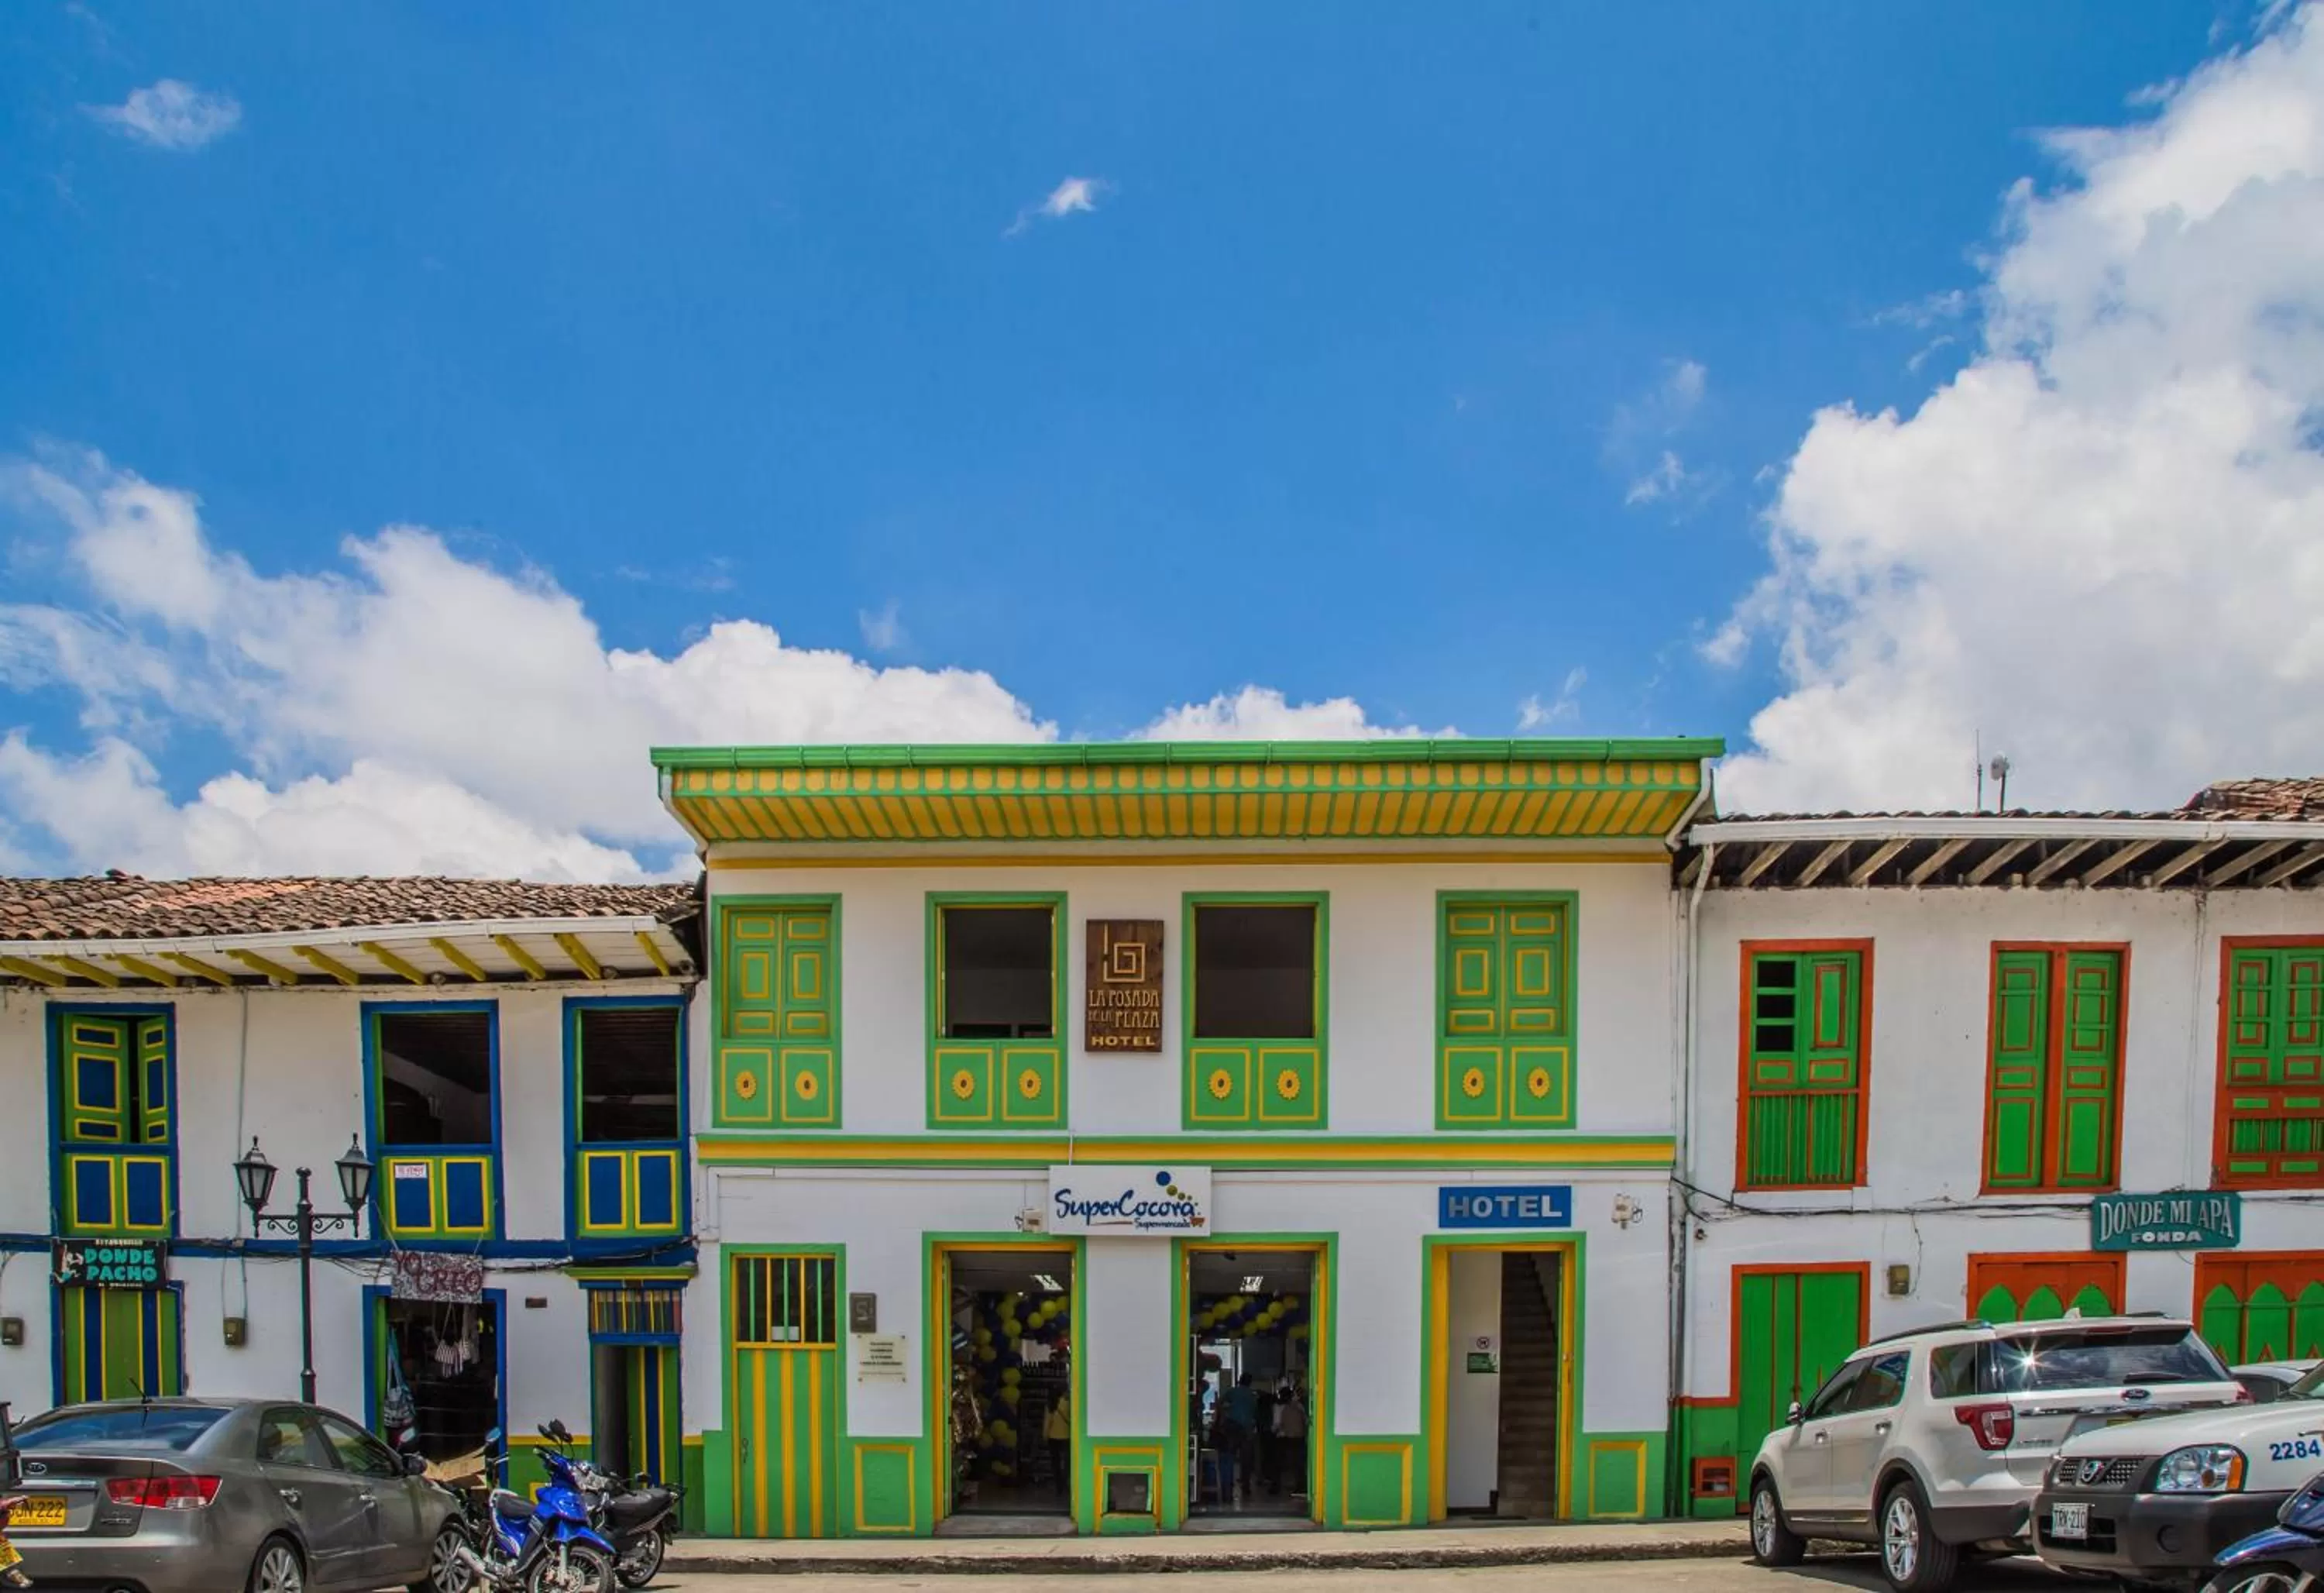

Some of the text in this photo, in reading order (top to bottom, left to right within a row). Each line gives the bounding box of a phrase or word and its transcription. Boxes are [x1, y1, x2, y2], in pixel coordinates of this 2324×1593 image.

[1088, 989, 1160, 1007] LA POSADA
[1116, 1010, 1160, 1028] PLAZA
[1092, 1036, 1155, 1047] HOTEL
[1448, 1195, 1563, 1219] HOTEL
[2100, 1200, 2165, 1243] DONDE
[2170, 1199, 2194, 1224] MI
[2131, 1230, 2203, 1244] FONDA
[84, 1247, 156, 1264] DONDE
[86, 1264, 158, 1283] PACHO
[2267, 1438, 2322, 1462] 2284
